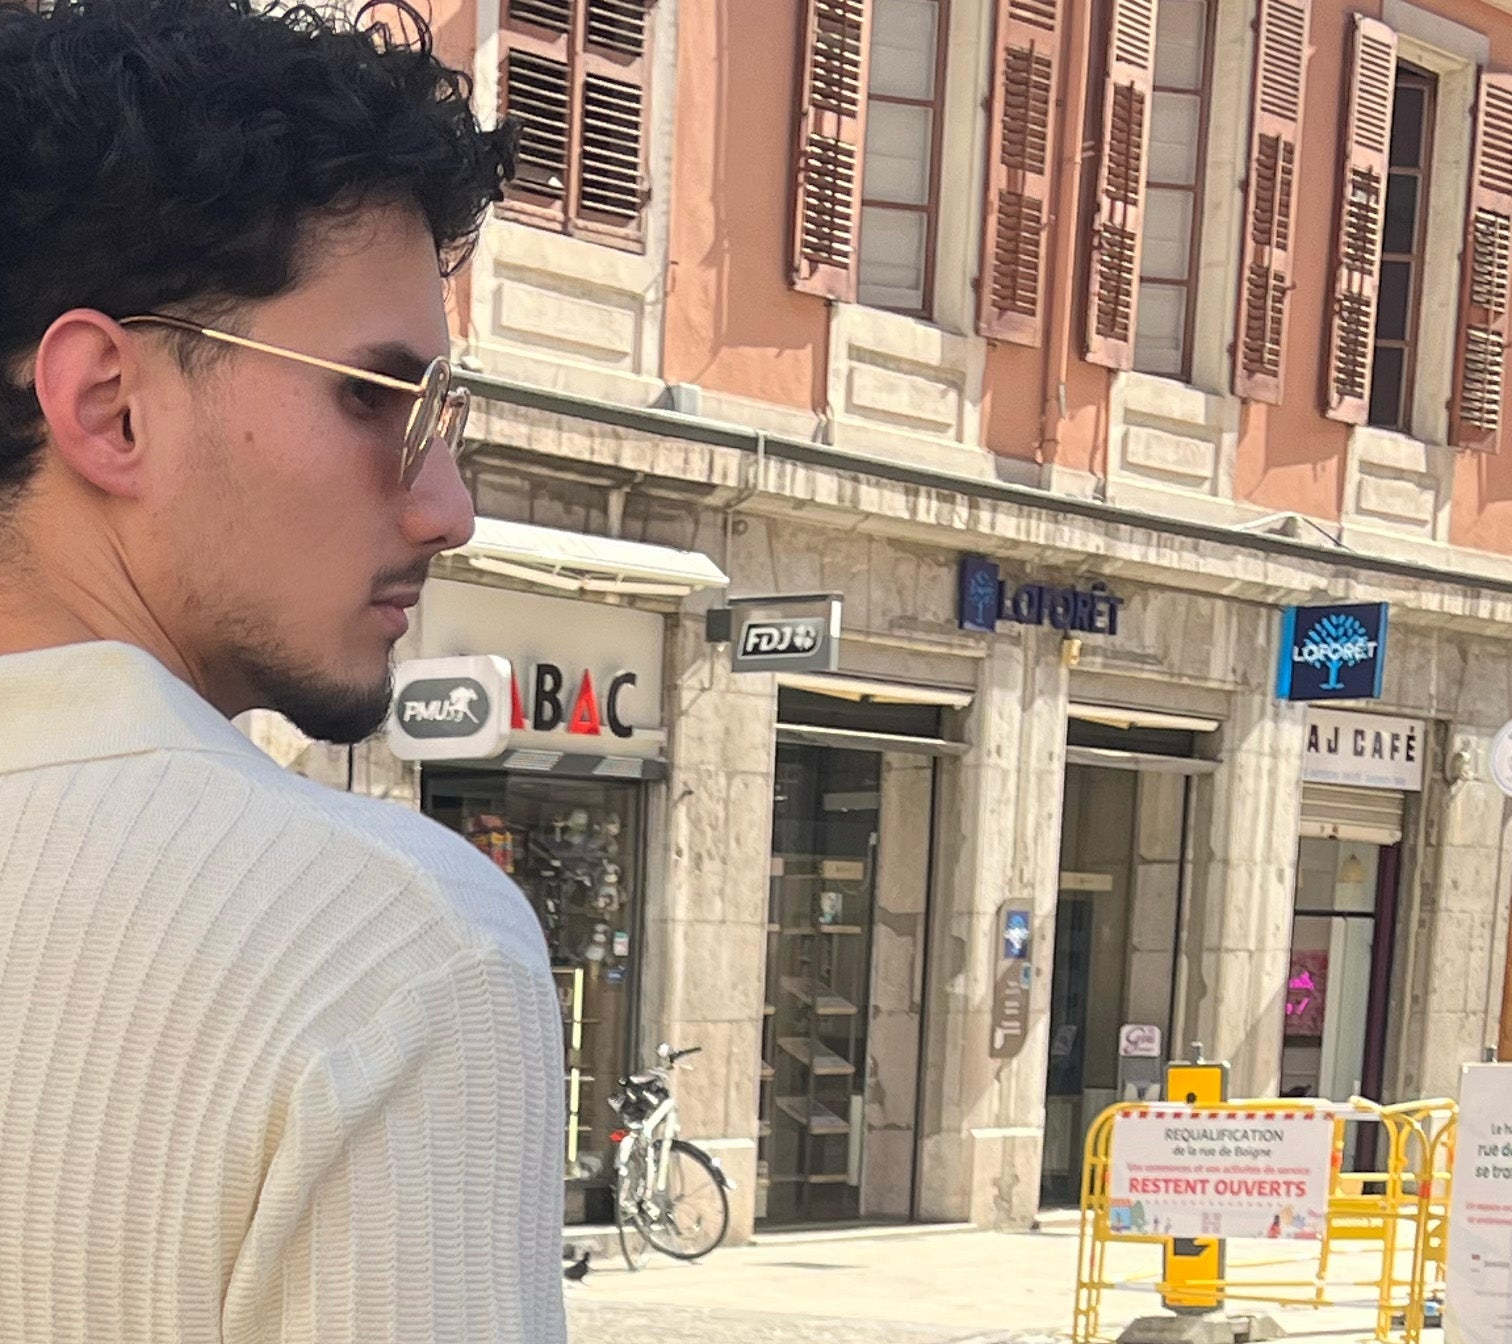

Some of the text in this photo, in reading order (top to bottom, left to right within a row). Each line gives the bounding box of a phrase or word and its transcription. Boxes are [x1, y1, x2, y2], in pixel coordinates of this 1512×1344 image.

[997, 581, 1125, 636] LOFORÊT
[746, 626, 792, 653] FDJ
[403, 700, 453, 723] PMU
[510, 664, 637, 738] BAC
[1353, 725, 1416, 762] CAFÉ
[1164, 1127, 1284, 1144] REQUALIFICATION
[1129, 1177, 1307, 1198] RESTENT OUVERTS
